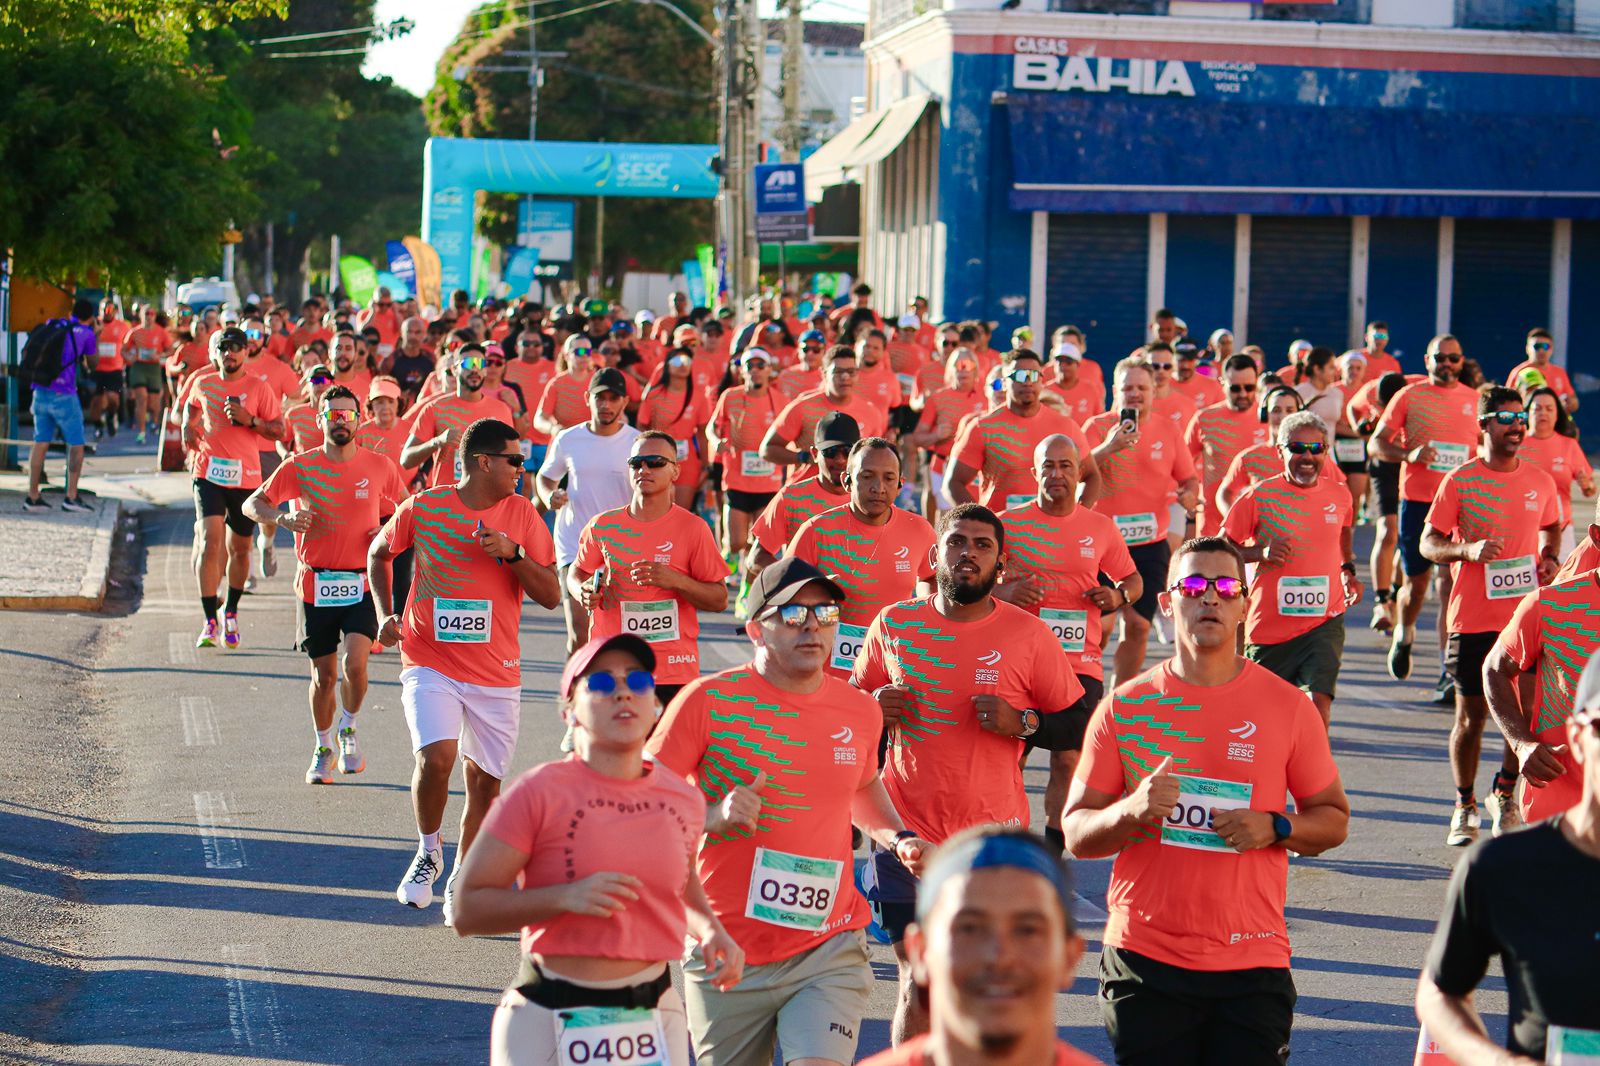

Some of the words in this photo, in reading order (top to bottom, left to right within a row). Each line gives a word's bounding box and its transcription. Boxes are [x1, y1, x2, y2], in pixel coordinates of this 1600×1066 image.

[1014, 37, 1068, 55] CASAS
[1013, 54, 1195, 96] BAHIA
[616, 162, 671, 180] SESC
[211, 467, 238, 479] 0337
[1120, 525, 1153, 537] 0375
[1492, 571, 1532, 587] 0015
[320, 585, 359, 597] 0293
[1284, 592, 1326, 605] 0100
[438, 616, 486, 630] 0428
[627, 616, 673, 631] 0429
[1052, 626, 1085, 640] 060
[668, 655, 697, 664] BAHIA
[1227, 747, 1255, 758] SESC
[1198, 785, 1219, 793] SESC
[566, 809, 585, 840] AND
[588, 798, 651, 814] CONQUER
[760, 879, 830, 911] 0338
[830, 1022, 853, 1039] FILA
[568, 1033, 657, 1064] 0408
